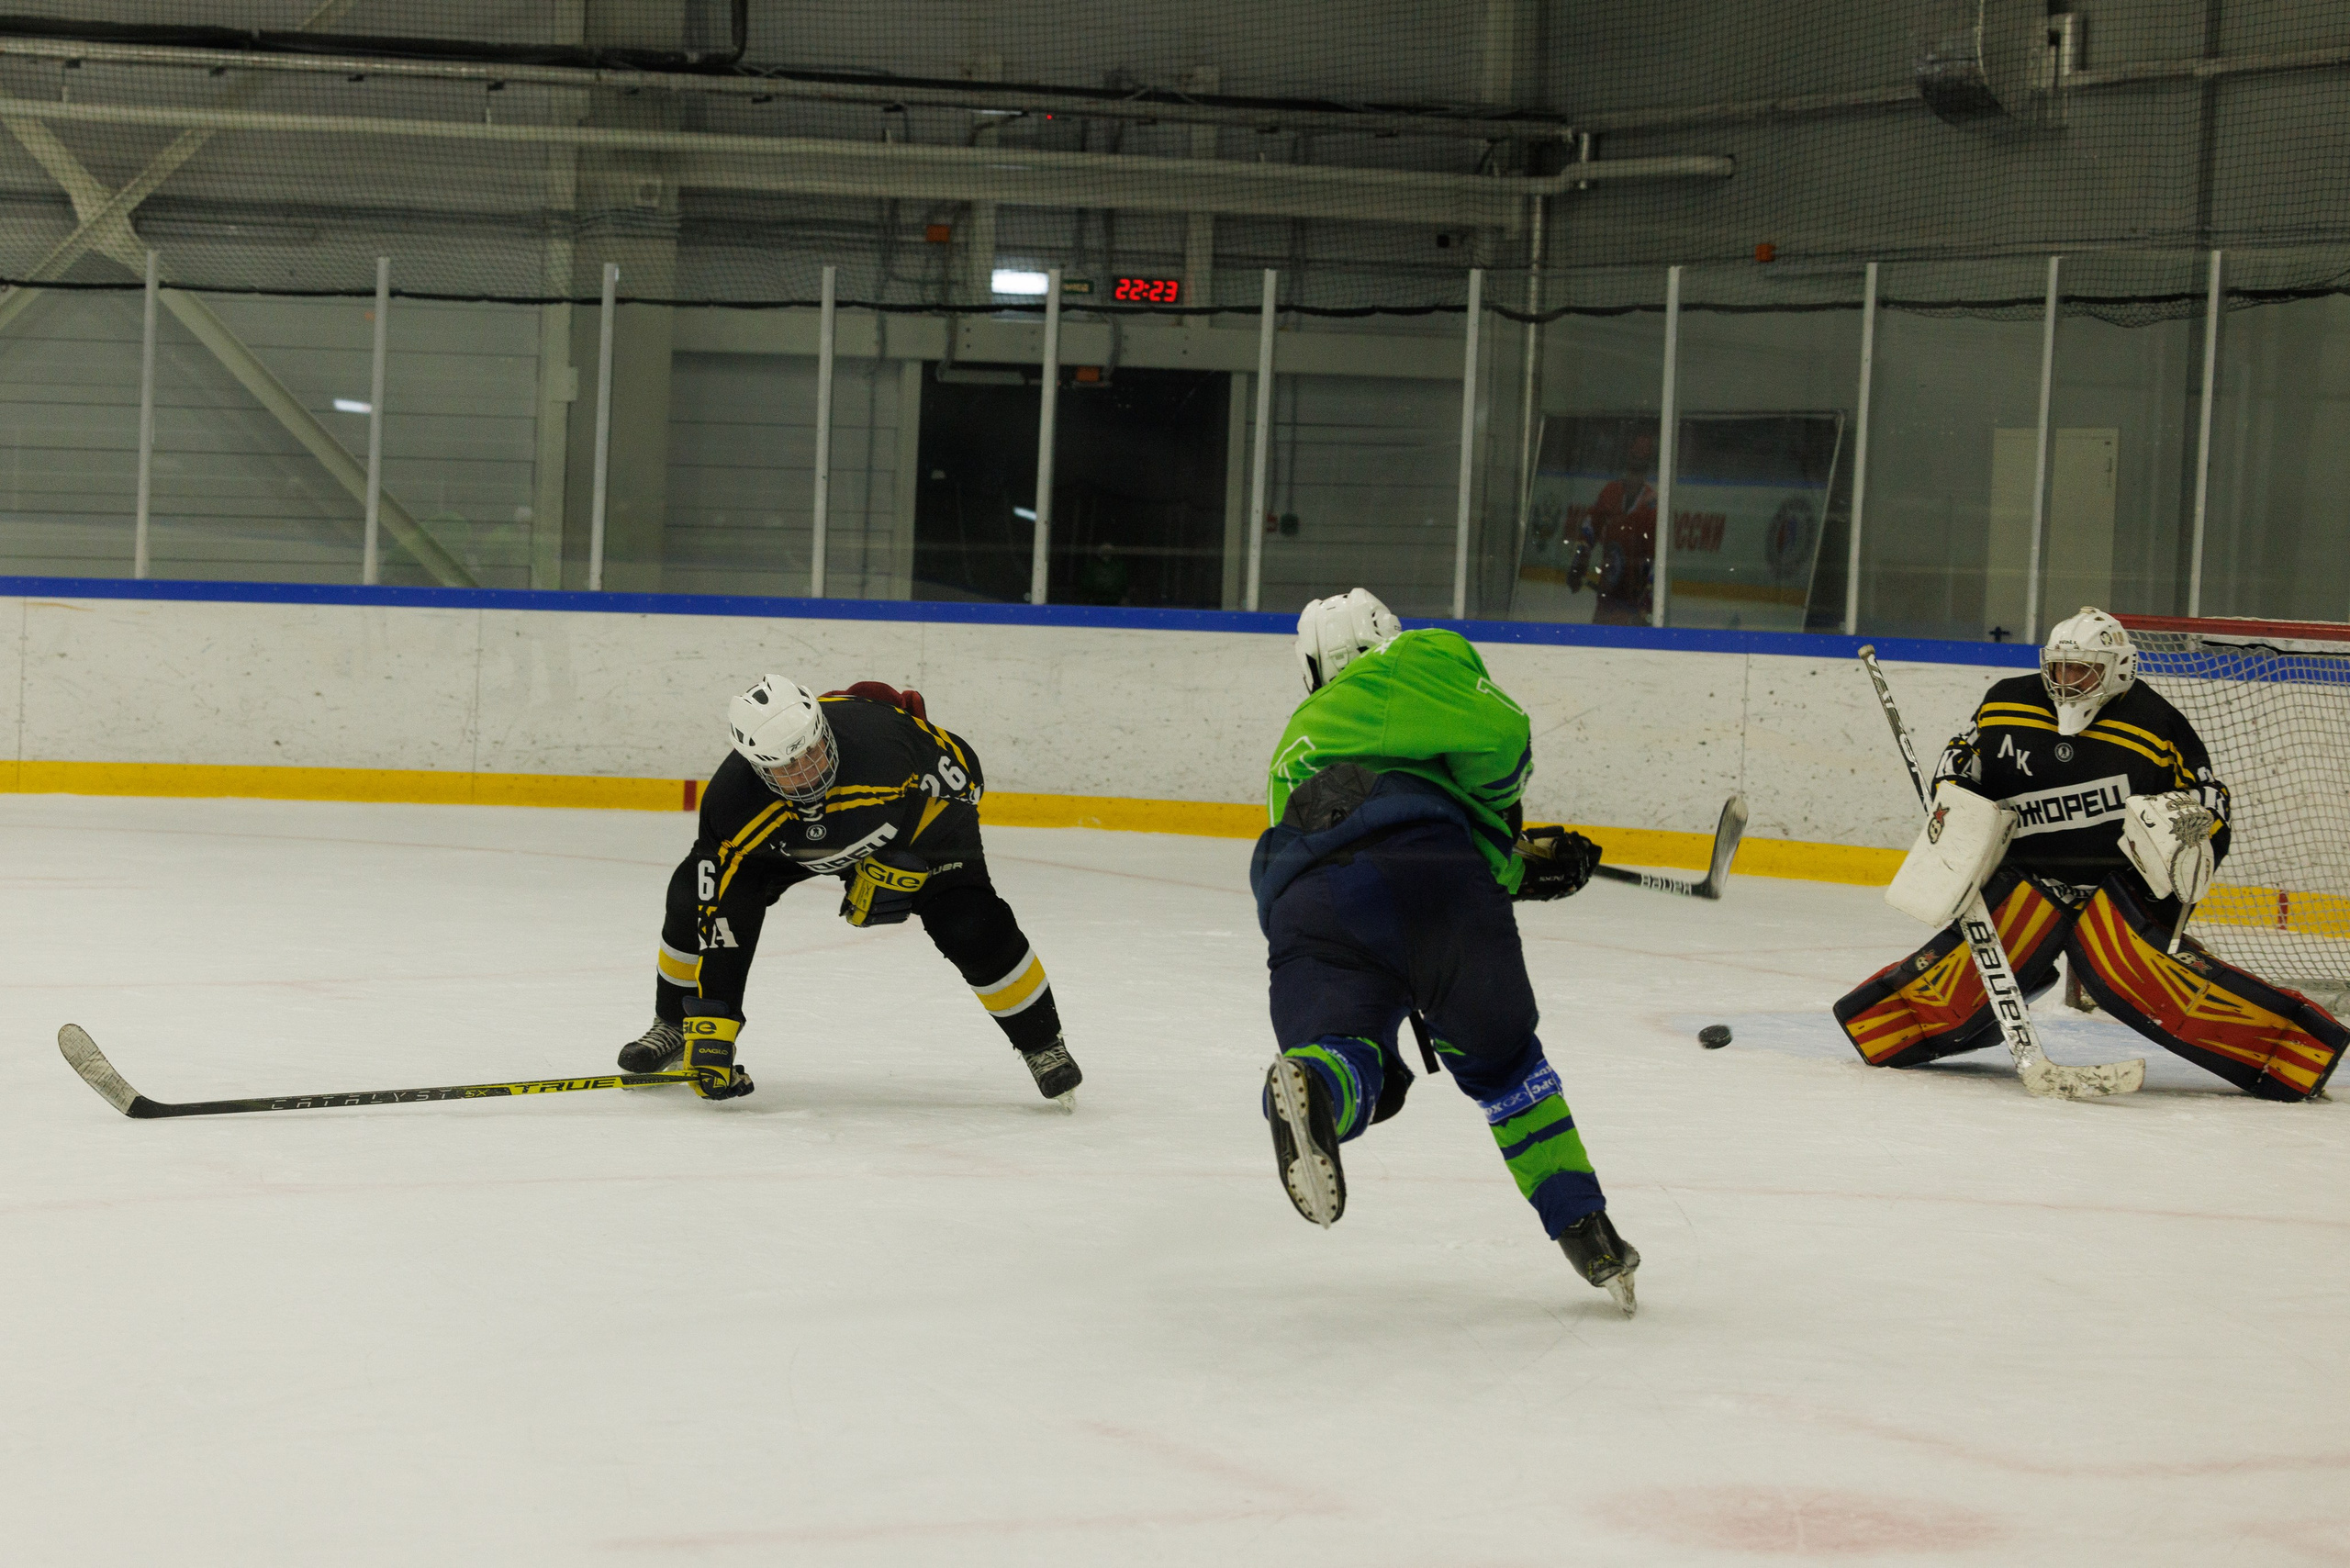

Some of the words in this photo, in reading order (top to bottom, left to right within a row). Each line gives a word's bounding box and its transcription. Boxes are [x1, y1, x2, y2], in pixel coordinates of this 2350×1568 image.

[1115, 278, 1178, 303] 22:23
[920, 756, 967, 798] 26
[514, 1078, 617, 1094] TRUE
[272, 1089, 452, 1110] CATALYST
